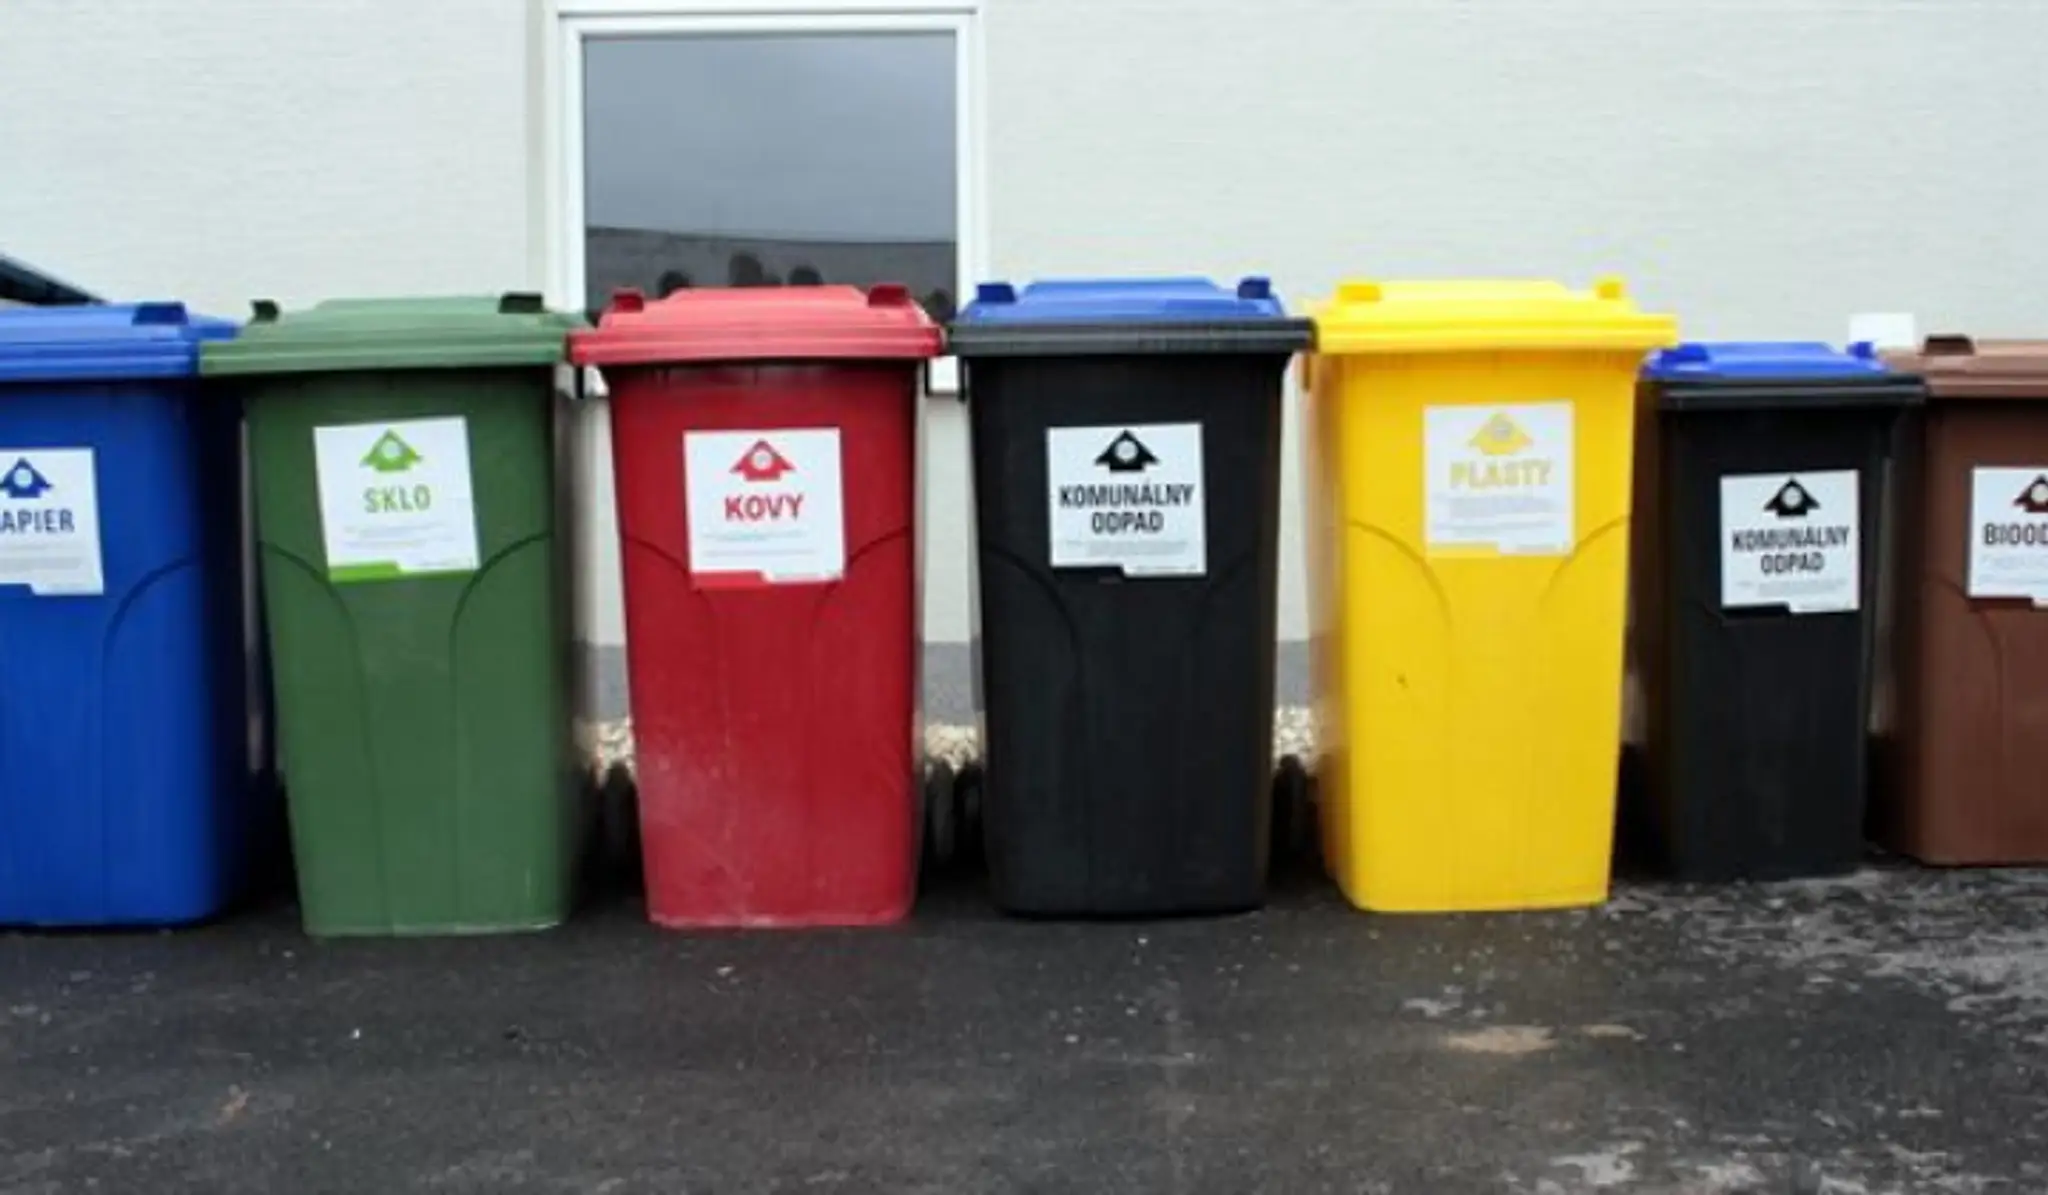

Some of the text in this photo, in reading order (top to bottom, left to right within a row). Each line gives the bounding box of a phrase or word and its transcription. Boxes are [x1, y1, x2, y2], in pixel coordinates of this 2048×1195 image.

[1450, 459, 1552, 488] PLASTY
[362, 484, 431, 513] SKLO
[724, 494, 804, 521] KOVY
[1092, 511, 1164, 534] ODPAD
[1761, 551, 1825, 574] ODPAD
